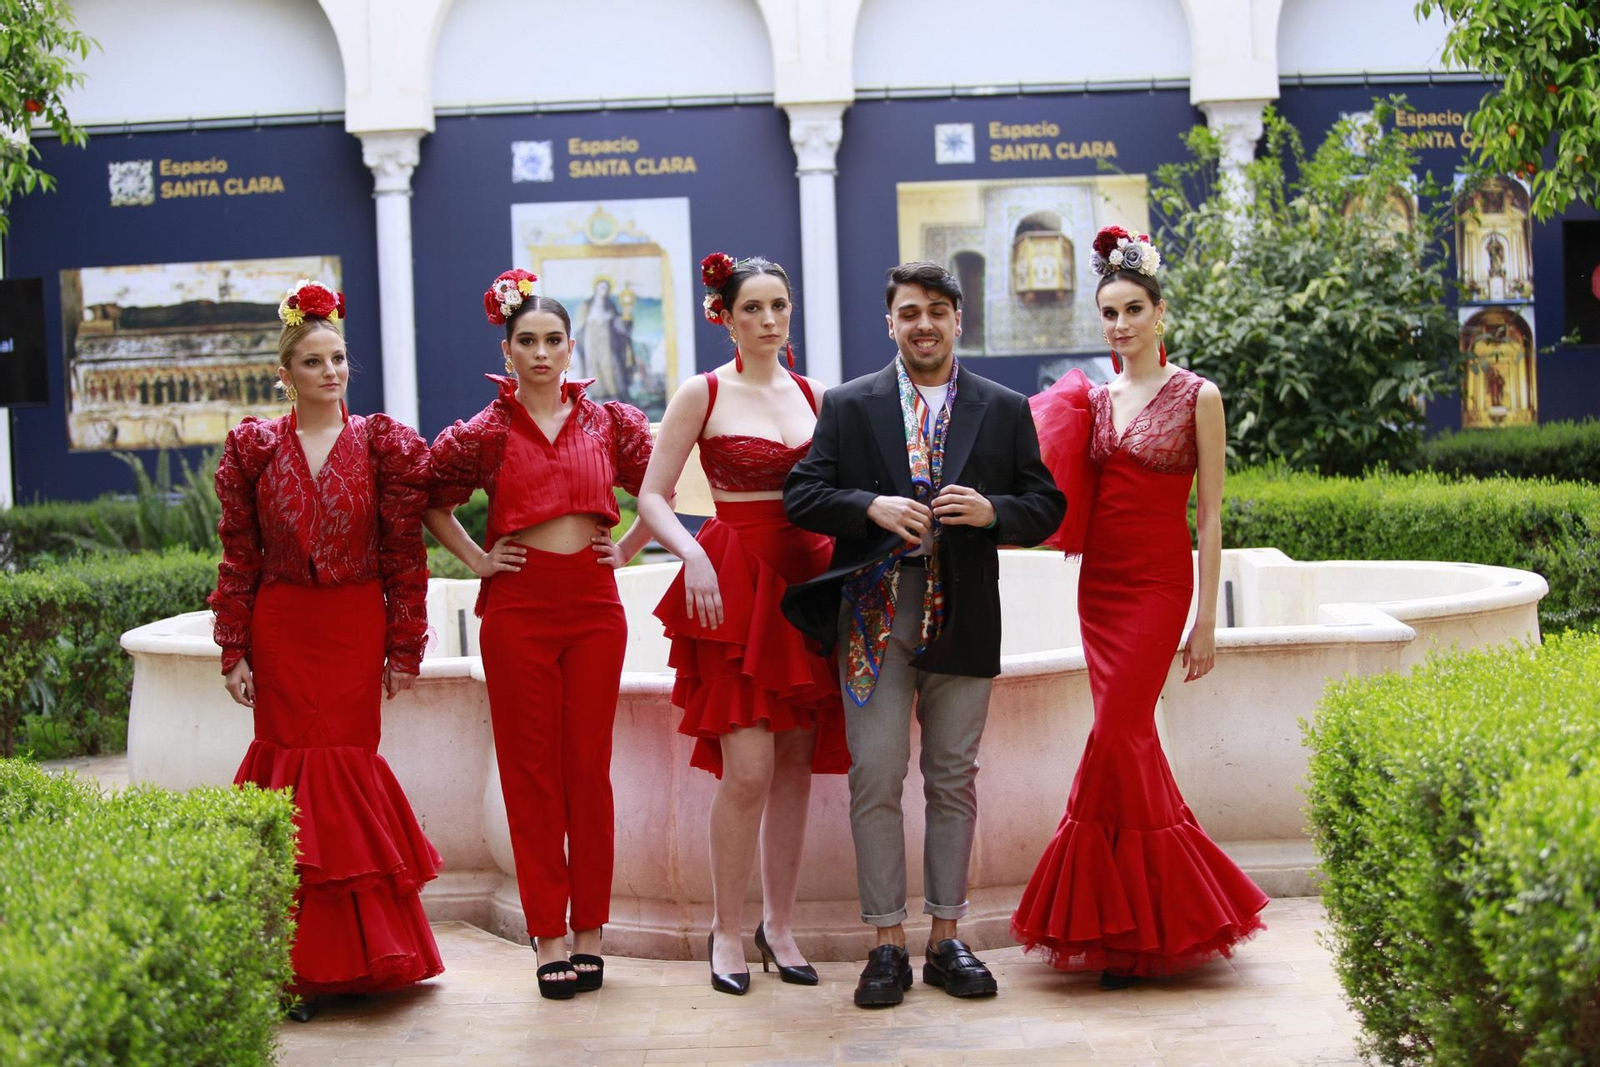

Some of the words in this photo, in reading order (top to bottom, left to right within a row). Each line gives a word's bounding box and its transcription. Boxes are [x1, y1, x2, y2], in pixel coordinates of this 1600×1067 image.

[1395, 109, 1463, 129] Espacio
[988, 120, 1060, 141] Espacio
[568, 136, 640, 157] Espacio
[990, 143, 1052, 162] SANTA
[1055, 141, 1118, 159] CLARA
[160, 156, 228, 177] Espacio
[569, 159, 631, 178] SANTA
[634, 156, 697, 175] CLARA
[160, 179, 221, 199] SANTA
[223, 176, 285, 195] CLARA
